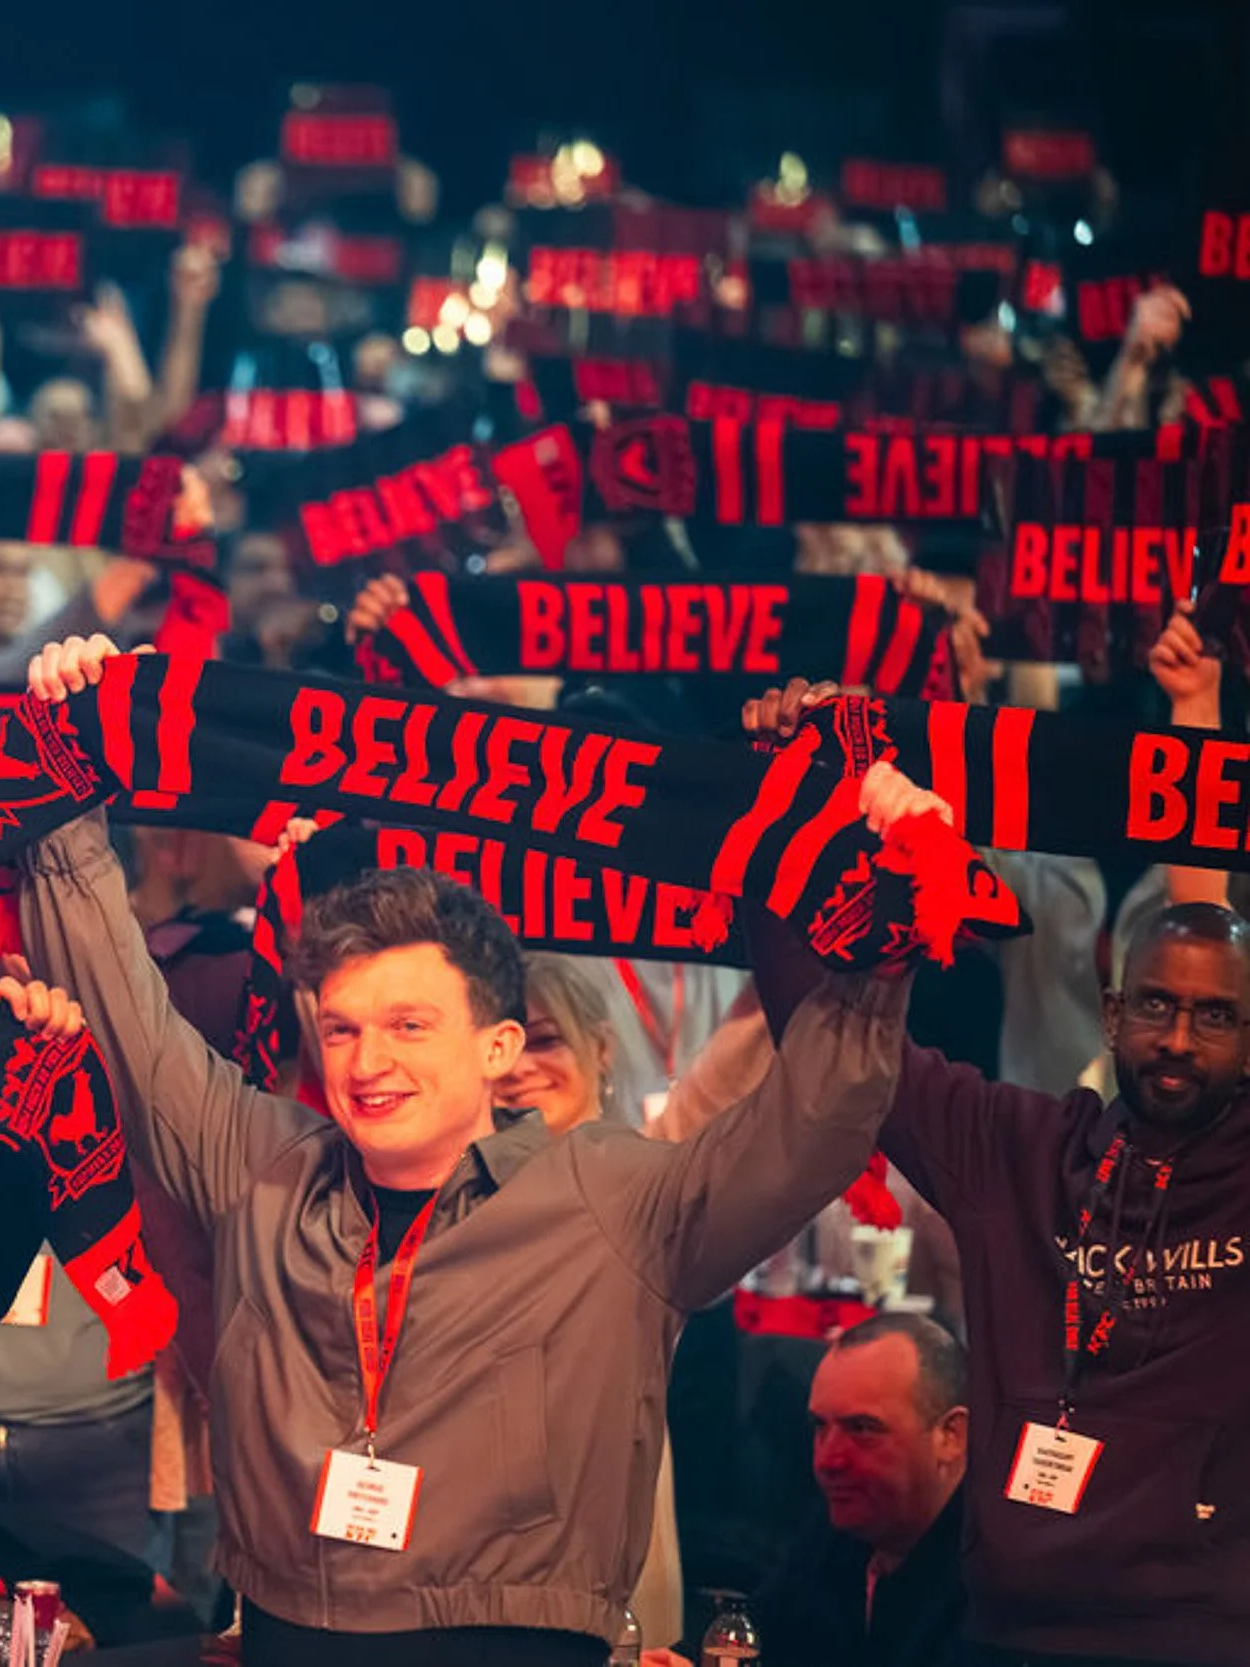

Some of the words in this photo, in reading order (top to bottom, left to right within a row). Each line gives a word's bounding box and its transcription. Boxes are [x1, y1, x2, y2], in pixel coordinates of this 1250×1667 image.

[517, 580, 789, 673] BELIEVE
[279, 686, 662, 848] BELIEVE
[1134, 1273, 1213, 1294] BRTAIN
